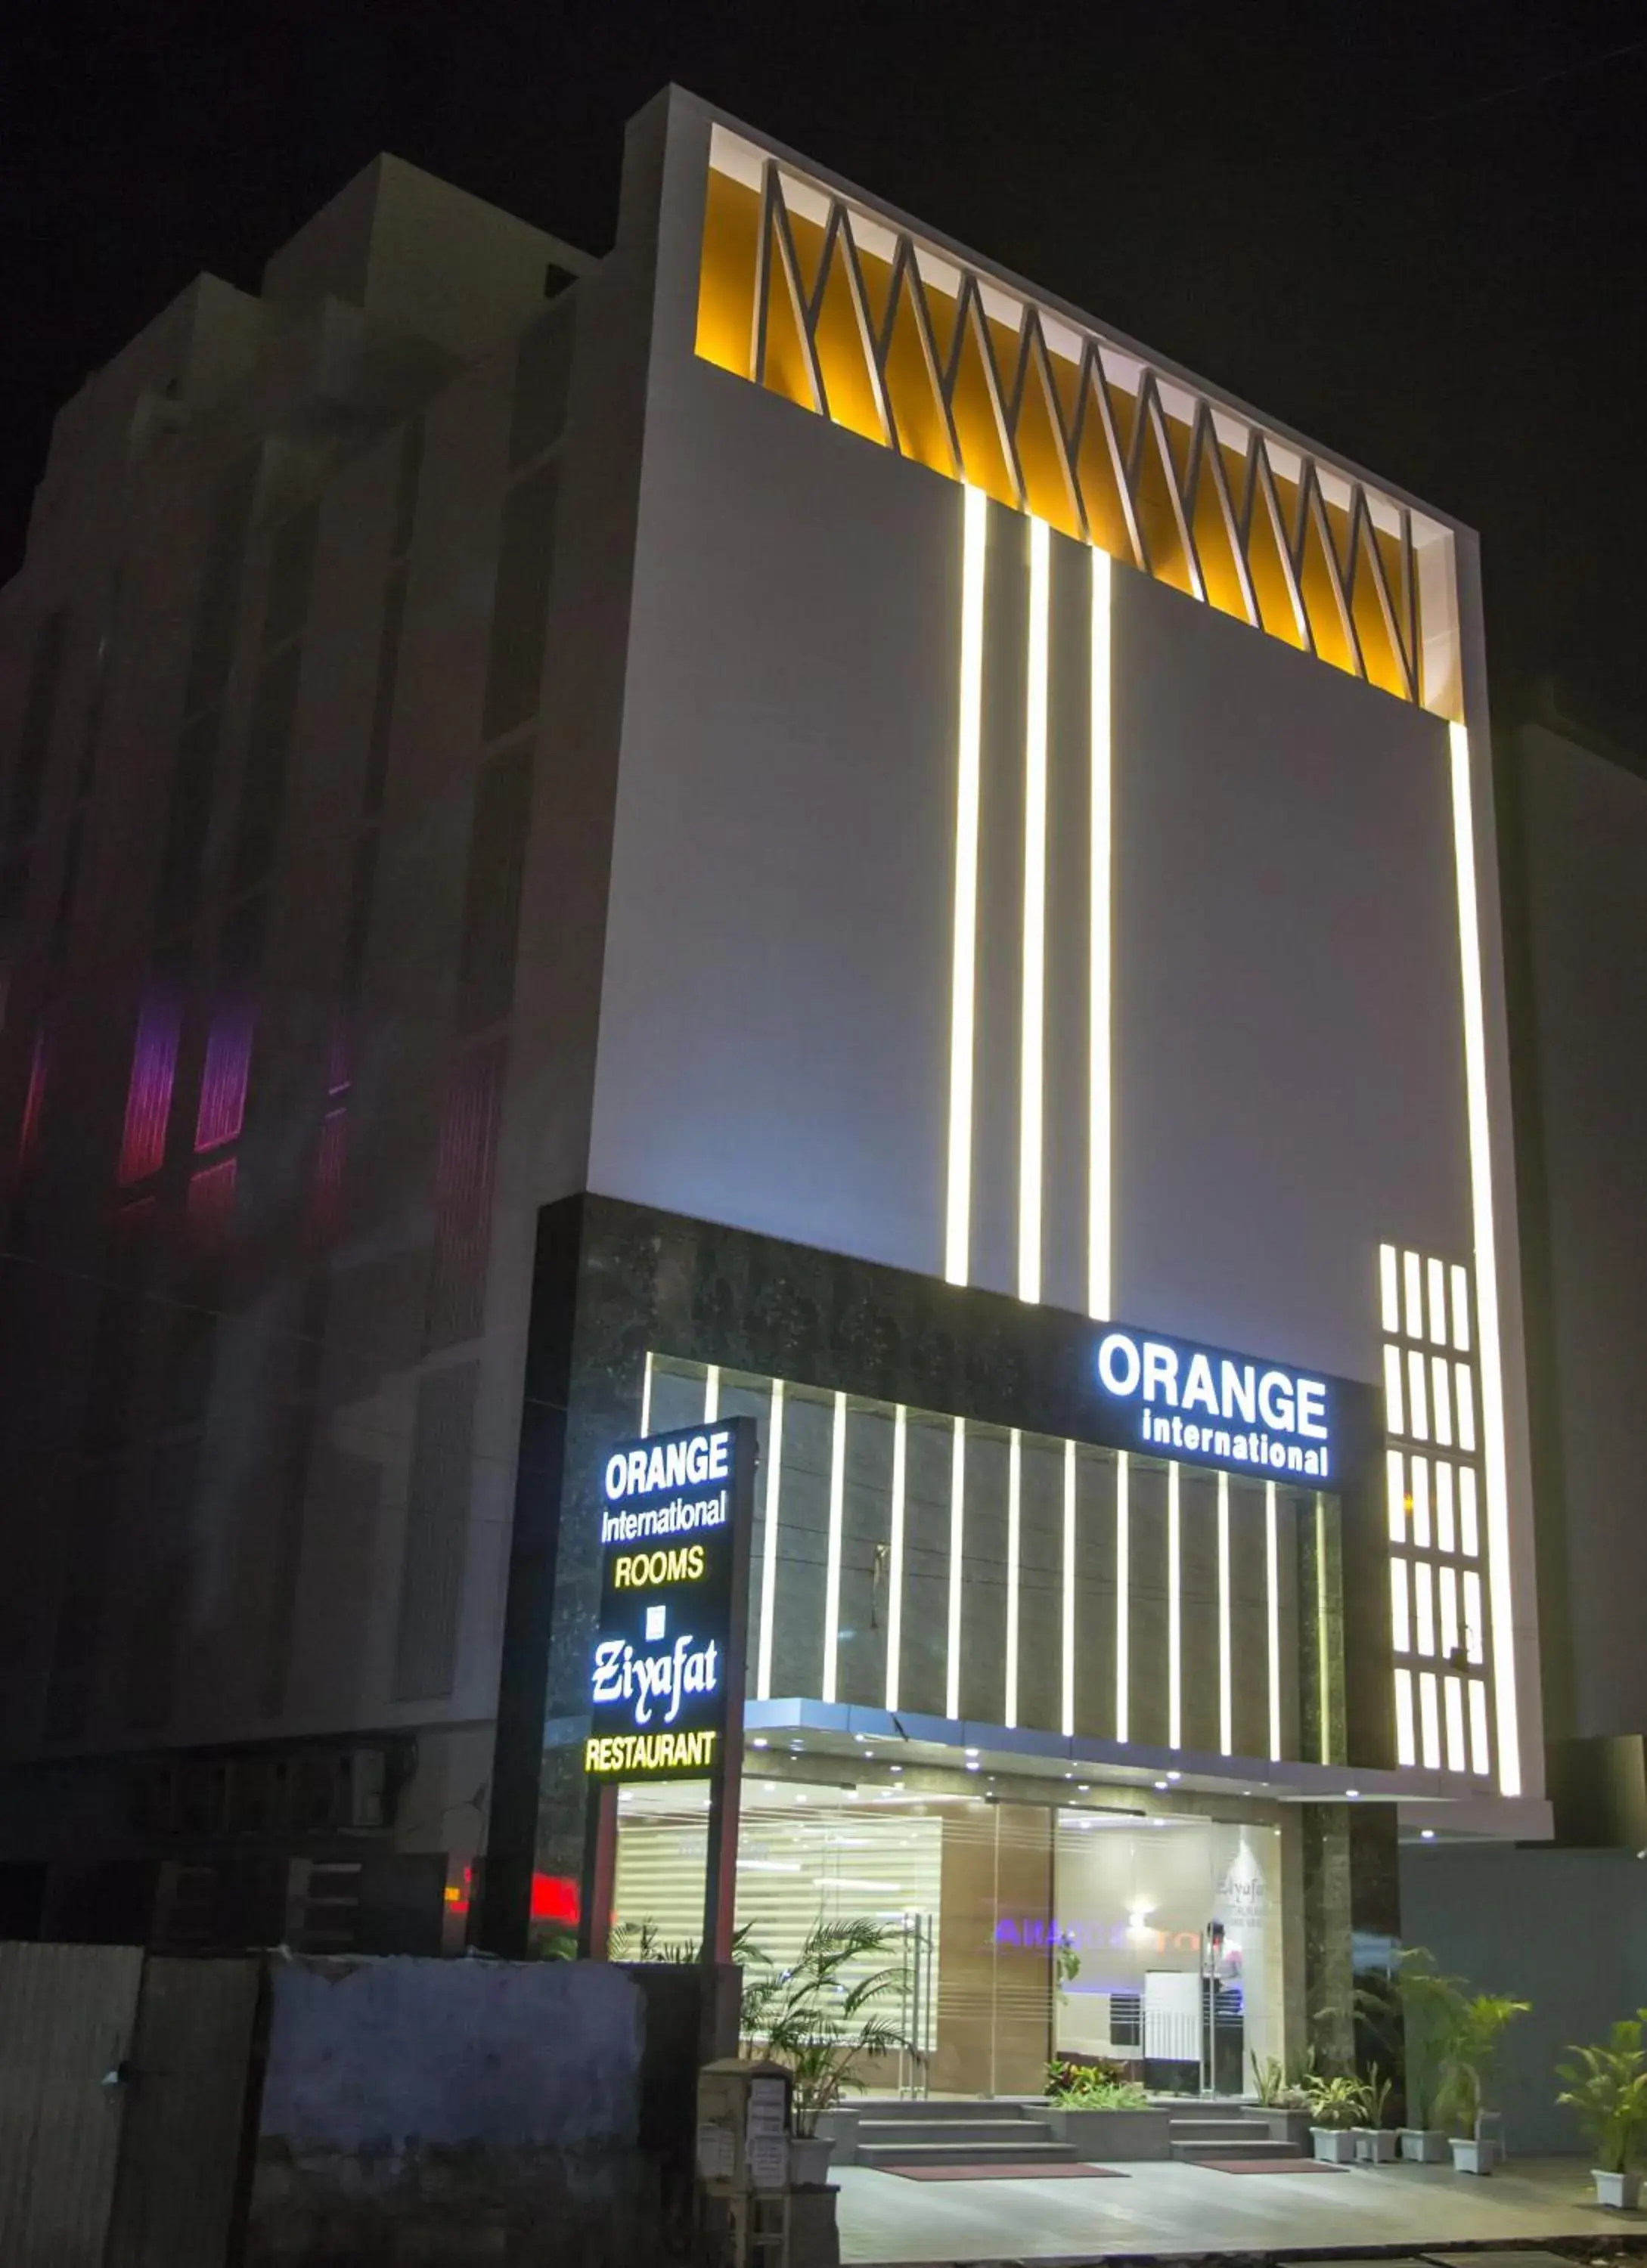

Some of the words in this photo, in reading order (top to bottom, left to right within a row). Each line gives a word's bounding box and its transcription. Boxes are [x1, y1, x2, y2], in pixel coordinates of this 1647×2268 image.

[1098, 1334, 1328, 1439] ORANGE
[606, 1432, 728, 1499] ORANGE
[1143, 1408, 1329, 1476] international
[615, 1545, 704, 1588] ROOMS
[592, 1635, 718, 1724] Ziyafat
[585, 1731, 715, 1772] RESTAURANT
